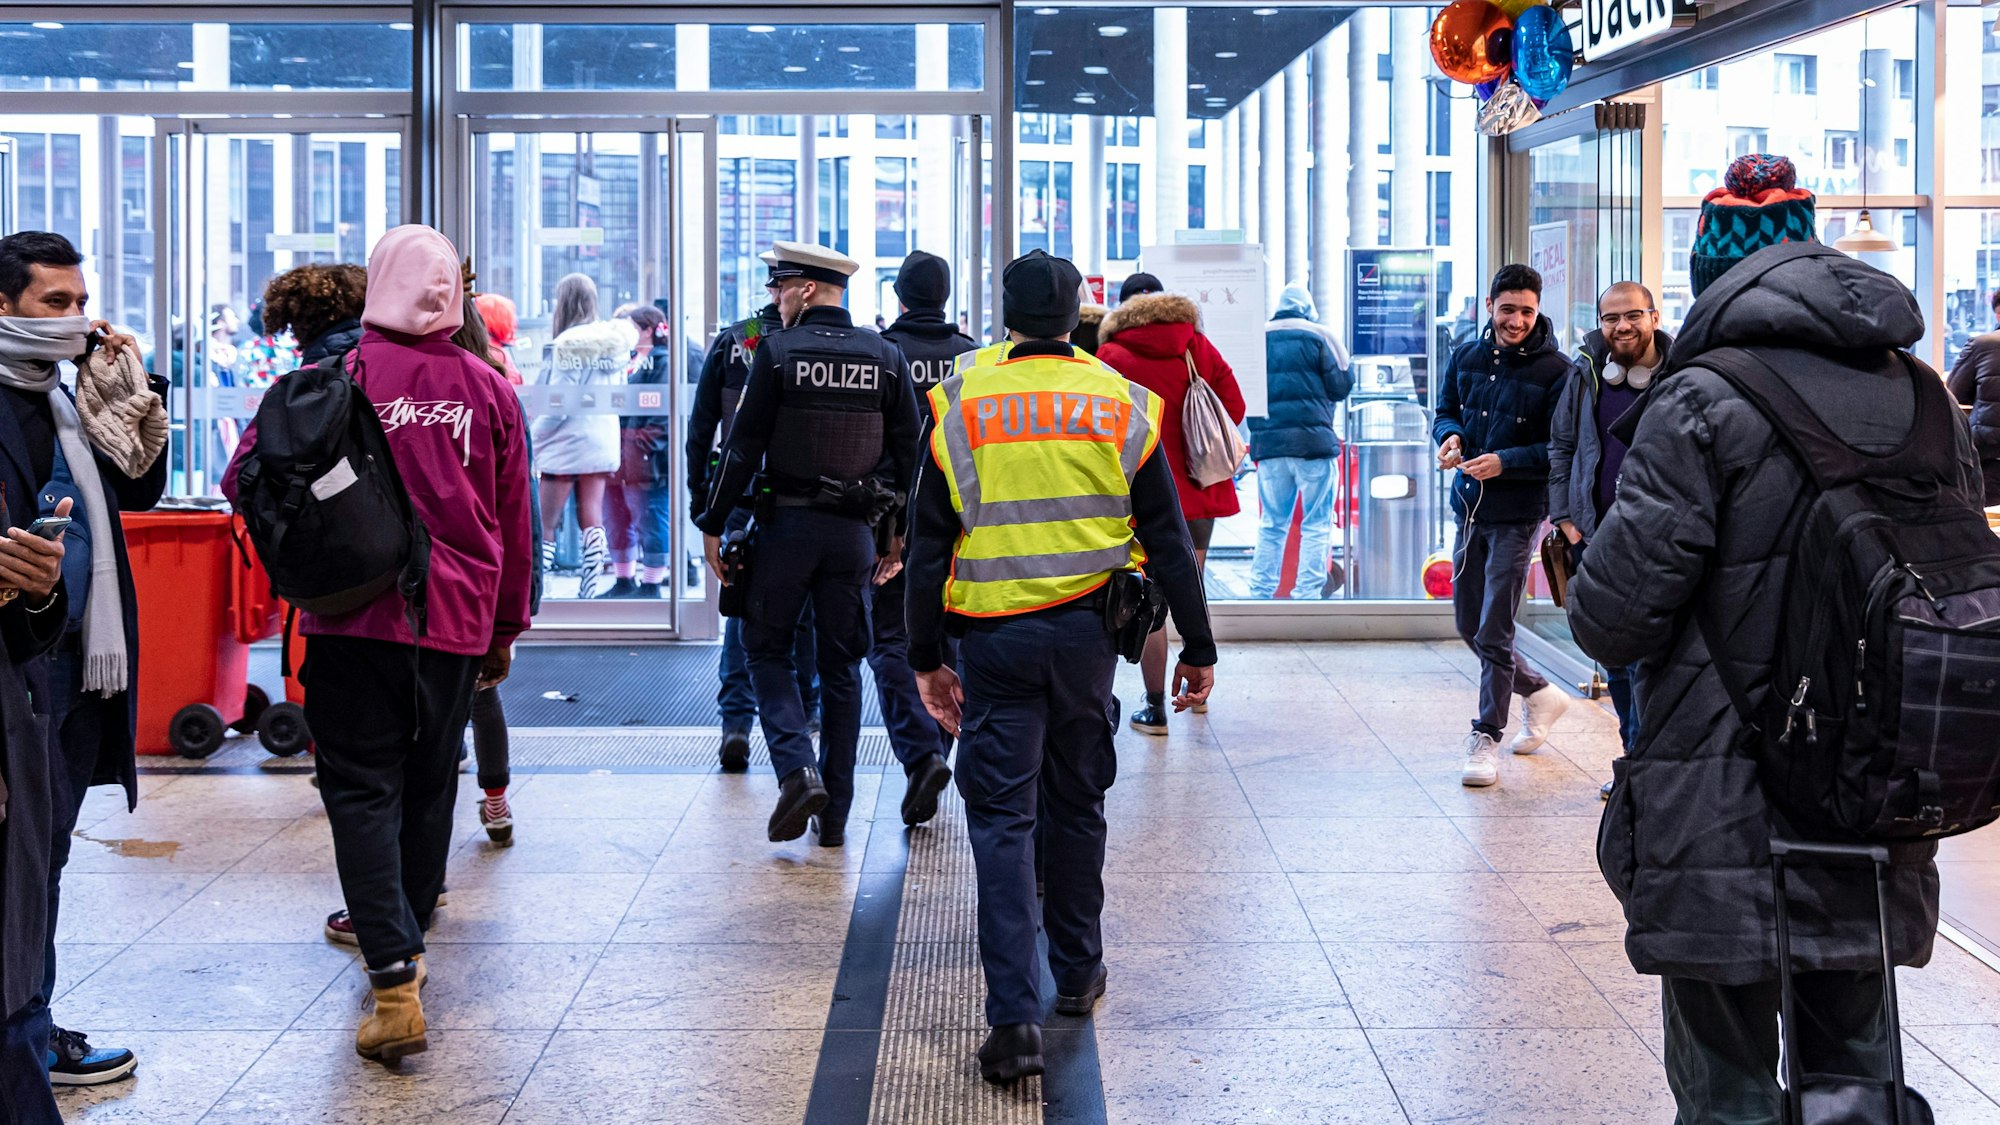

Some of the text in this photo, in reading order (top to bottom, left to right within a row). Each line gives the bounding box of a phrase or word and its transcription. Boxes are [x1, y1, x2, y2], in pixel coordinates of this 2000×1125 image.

[1543, 241, 1565, 272] DEAL
[796, 361, 879, 390] POLIZEI
[906, 360, 954, 383] OLIZ
